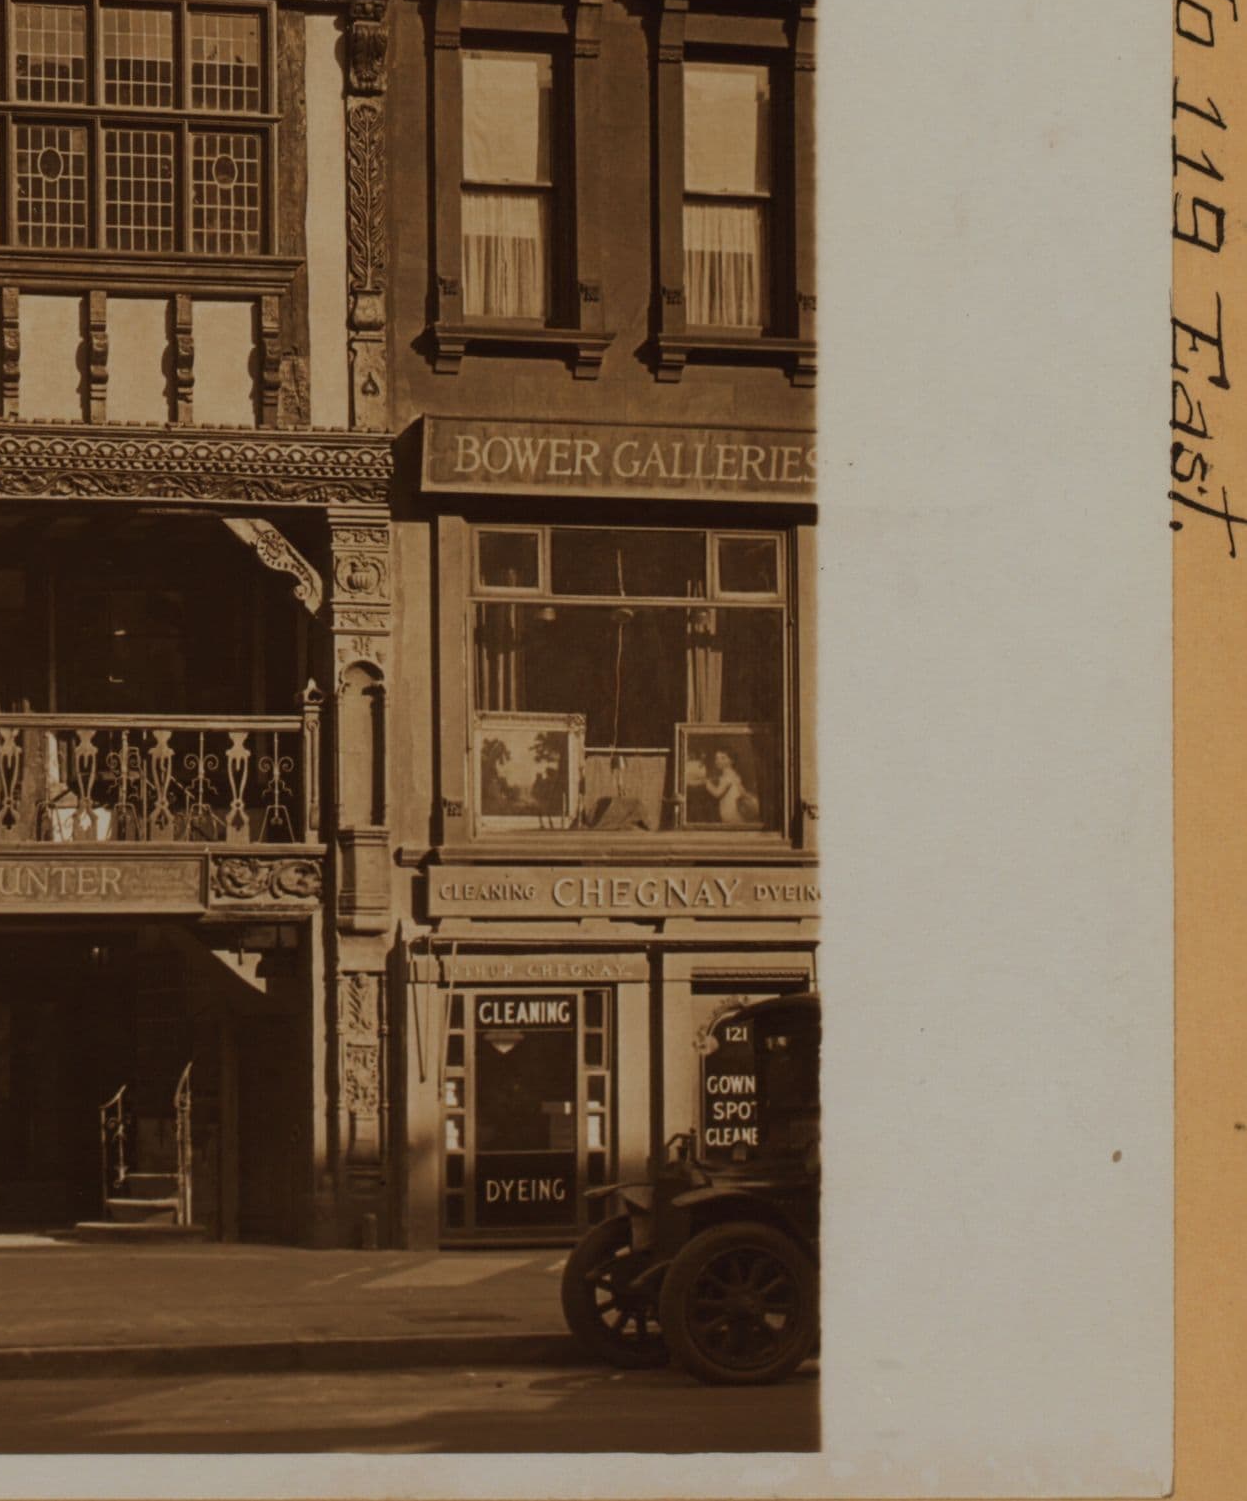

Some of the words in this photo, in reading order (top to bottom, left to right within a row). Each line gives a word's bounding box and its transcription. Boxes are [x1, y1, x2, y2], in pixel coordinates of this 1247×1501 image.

[1171, 76, 1228, 255] 119
[453, 434, 602, 477] BOWER
[611, 440, 818, 483] GALLERIES
[438, 883, 537, 902] CLEANING
[551, 876, 742, 908] CHEGNAY
[754, 883, 822, 902] DYEIN
[478, 1001, 571, 1025] CLEANING
[725, 1026, 748, 1043] 121
[706, 1075, 756, 1095] GOWN
[485, 1178, 566, 1203] DYEING
